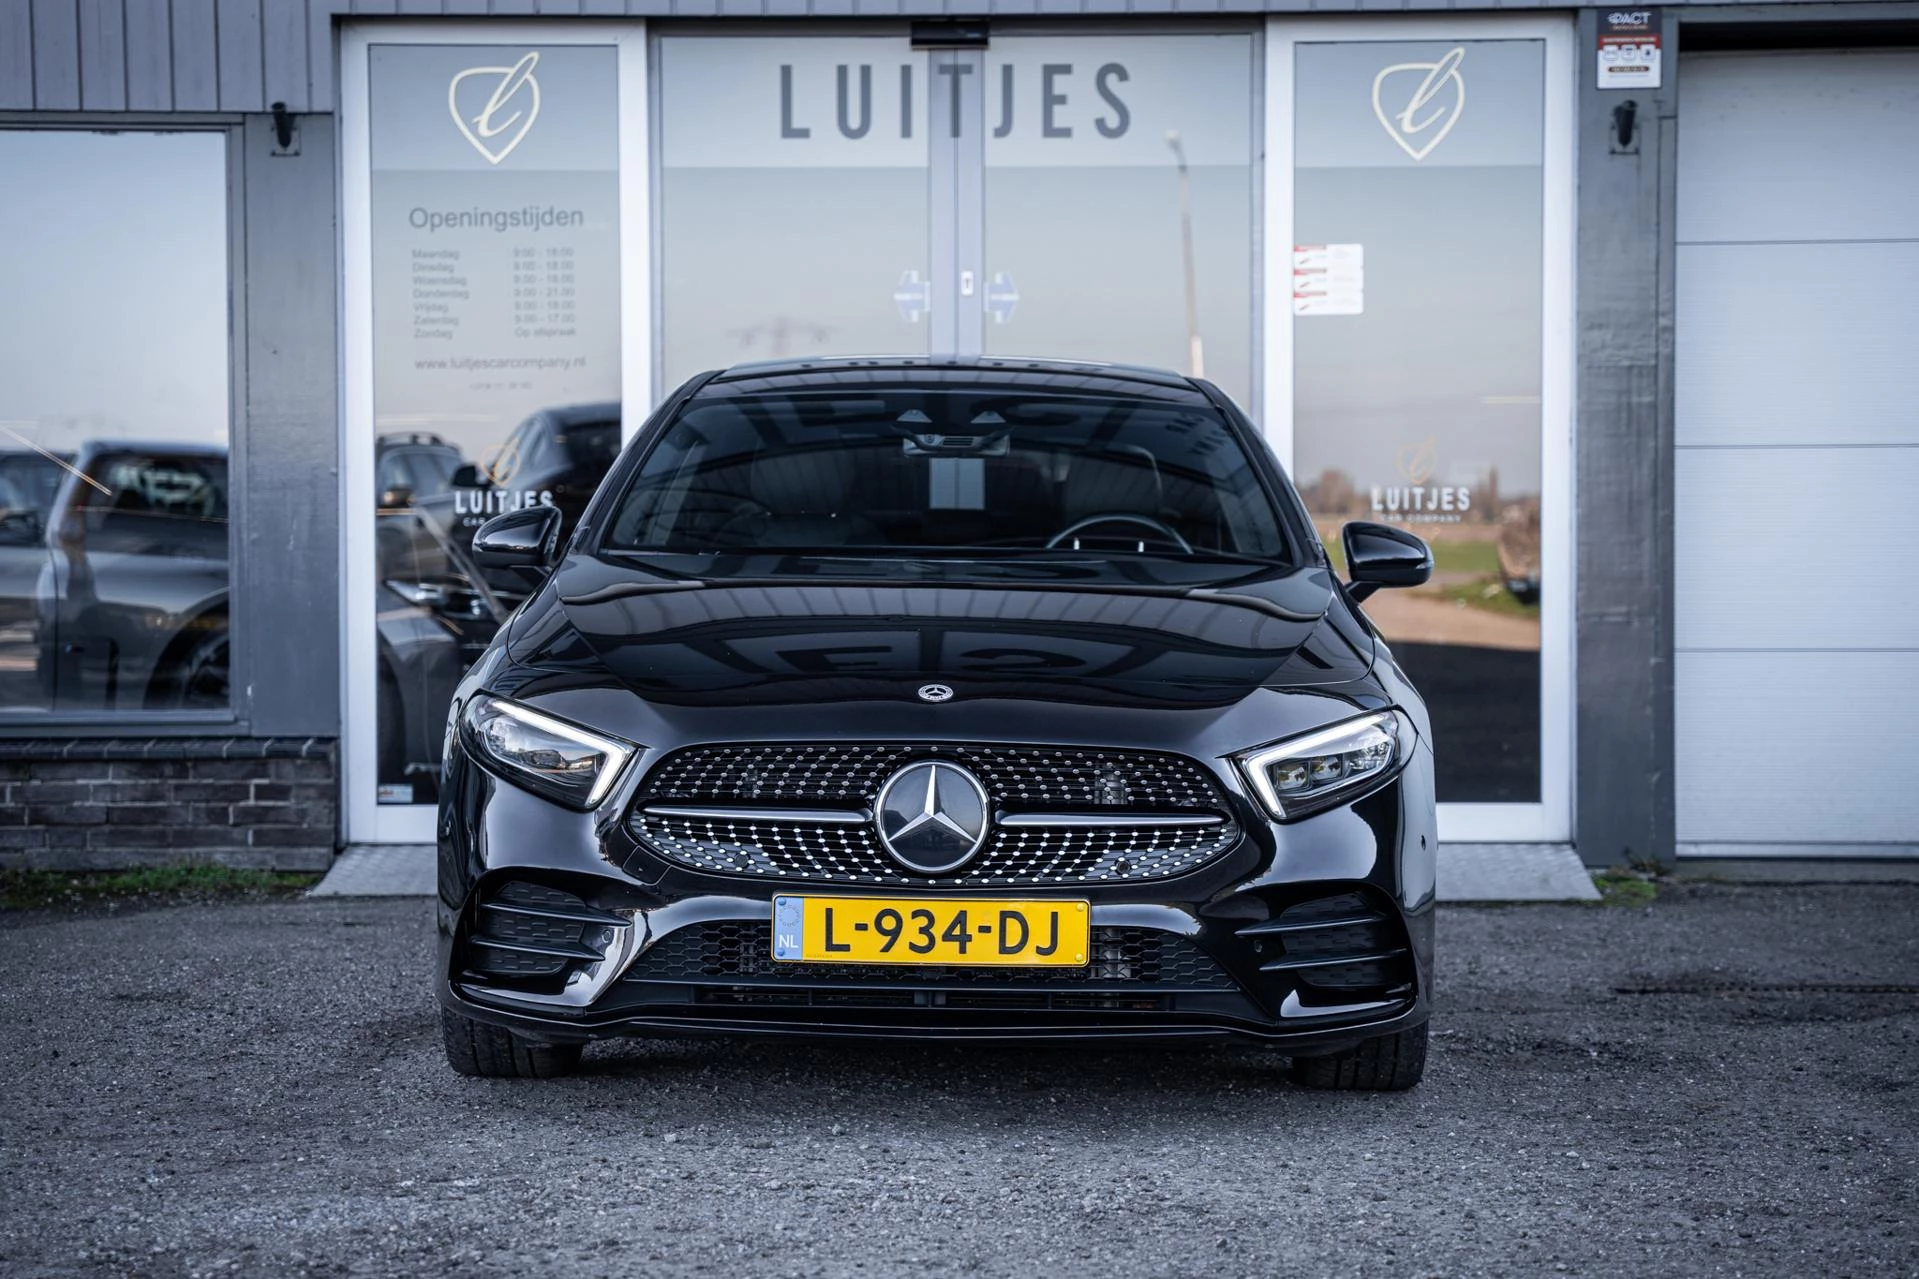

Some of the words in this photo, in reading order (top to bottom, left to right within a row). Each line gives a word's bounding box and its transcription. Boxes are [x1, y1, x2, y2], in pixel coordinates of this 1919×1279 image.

[780, 62, 1131, 139] LUITJES
[408, 206, 584, 232] Openingstijden
[455, 490, 554, 514] LUITJES
[1371, 485, 1470, 511] LUITJES
[779, 934, 799, 948] NL
[825, 907, 1059, 956] L-934-DJ
